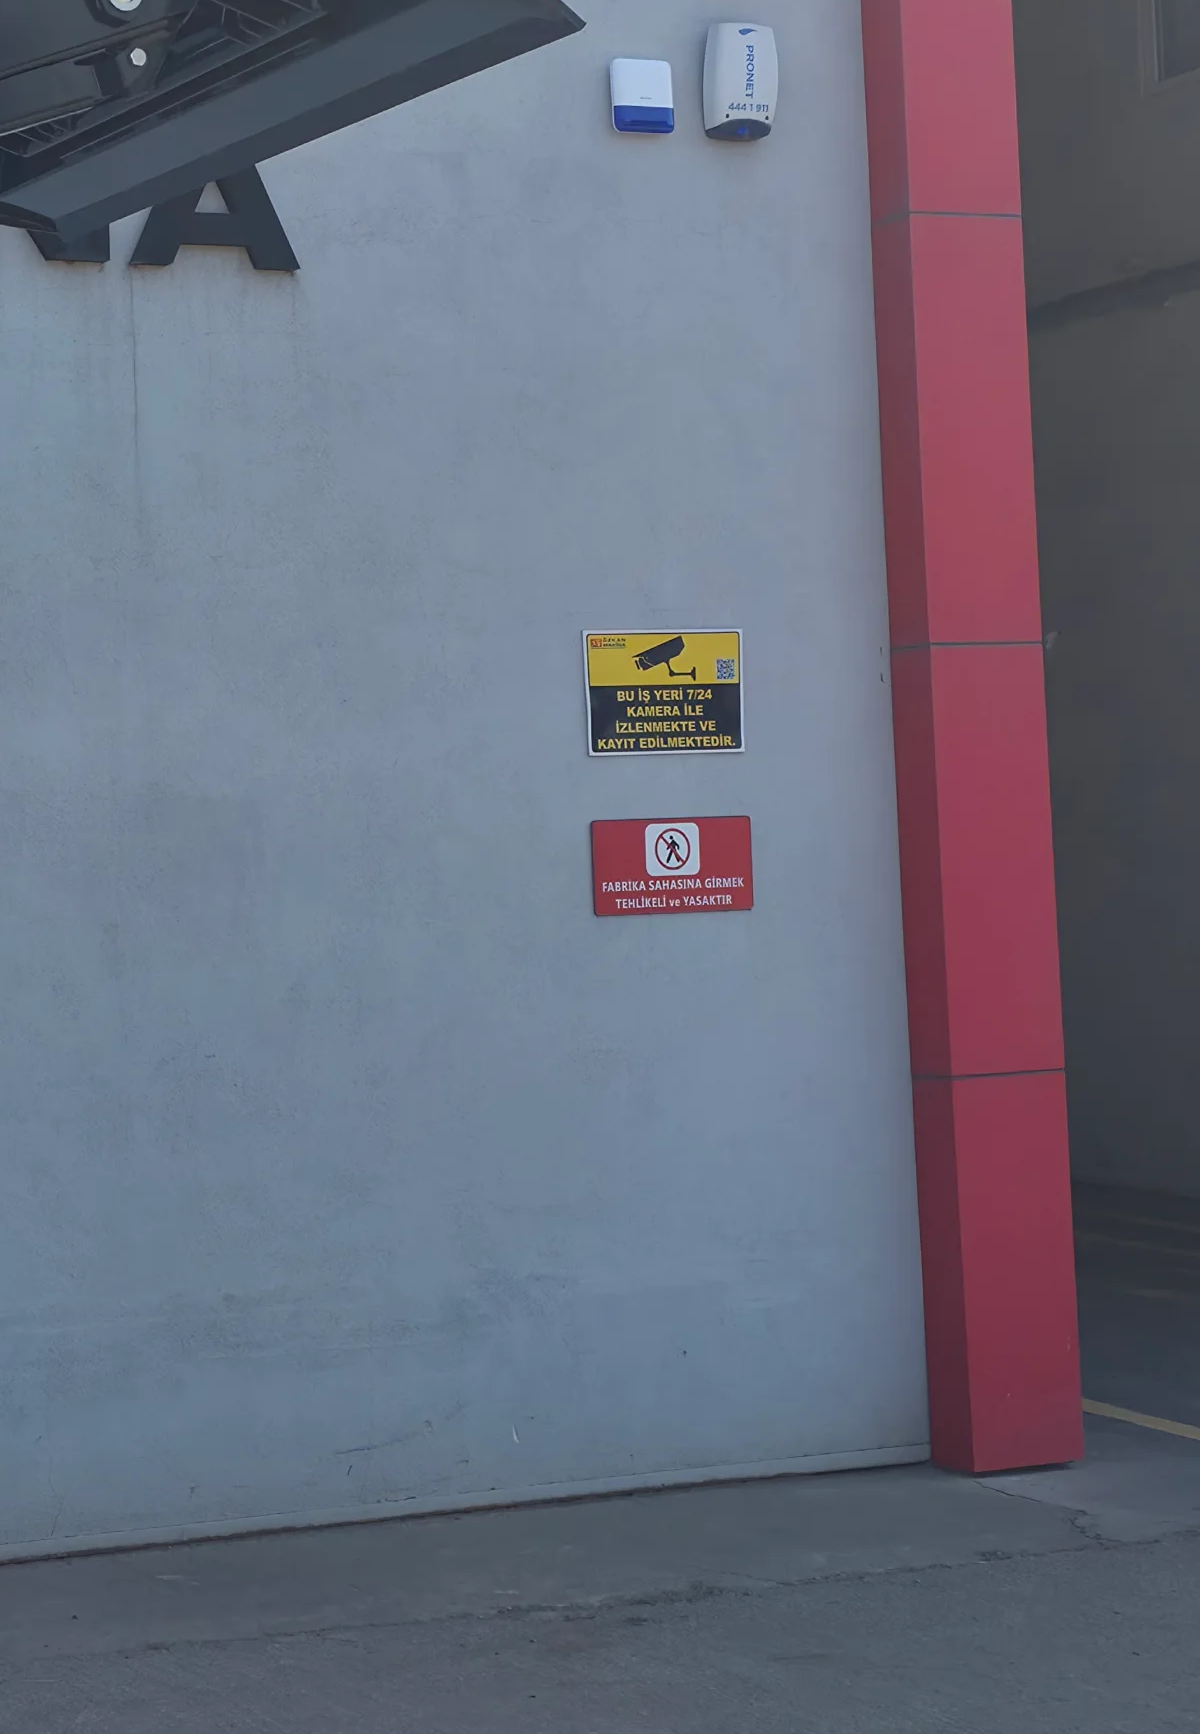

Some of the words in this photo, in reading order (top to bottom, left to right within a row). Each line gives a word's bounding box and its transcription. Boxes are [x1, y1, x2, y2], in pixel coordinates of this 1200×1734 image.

[745, 45, 755, 99] PRONET
[728, 102, 747, 111] 444
[756, 104, 769, 113] 911
[617, 690, 635, 701] BU
[638, 688, 651, 703] İŞ
[654, 687, 683, 701] YERİ
[687, 689, 713, 700] 7/24
[627, 706, 681, 717] KAMERA
[684, 703, 704, 716] İLE
[616, 720, 696, 734] İZLENMEKTE
[699, 720, 717, 731] VE
[598, 738, 636, 750] KAYIT
[639, 735, 736, 749] EDİLMEKTEDİR.
[648, 878, 702, 891] SAHASINA
[704, 875, 745, 889] GİRMEK
[615, 894, 667, 910] TEHLİKELİ
[669, 898, 681, 908] ve
[683, 894, 733, 907] YASAKTIR
